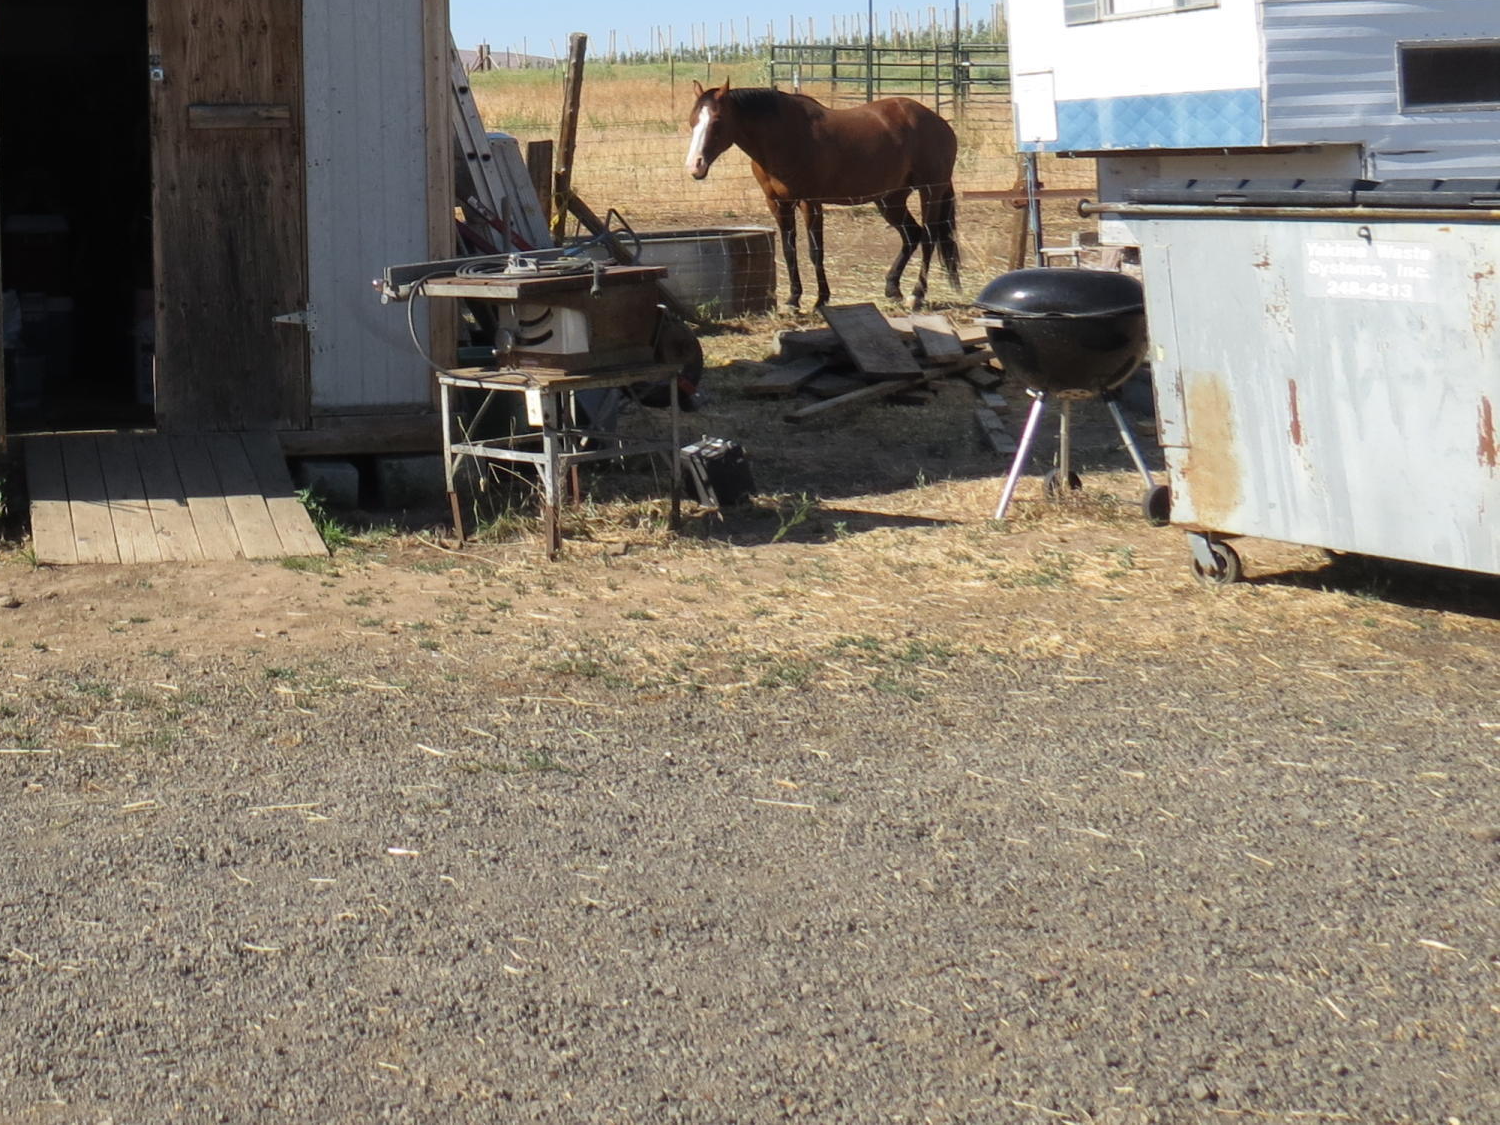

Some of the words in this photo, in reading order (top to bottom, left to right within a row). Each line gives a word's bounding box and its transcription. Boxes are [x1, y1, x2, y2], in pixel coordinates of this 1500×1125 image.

[1306, 242, 1367, 258] Yakima
[1376, 244, 1431, 260] Waste
[1308, 260, 1387, 278] Systems,
[1396, 263, 1430, 278] Inc.
